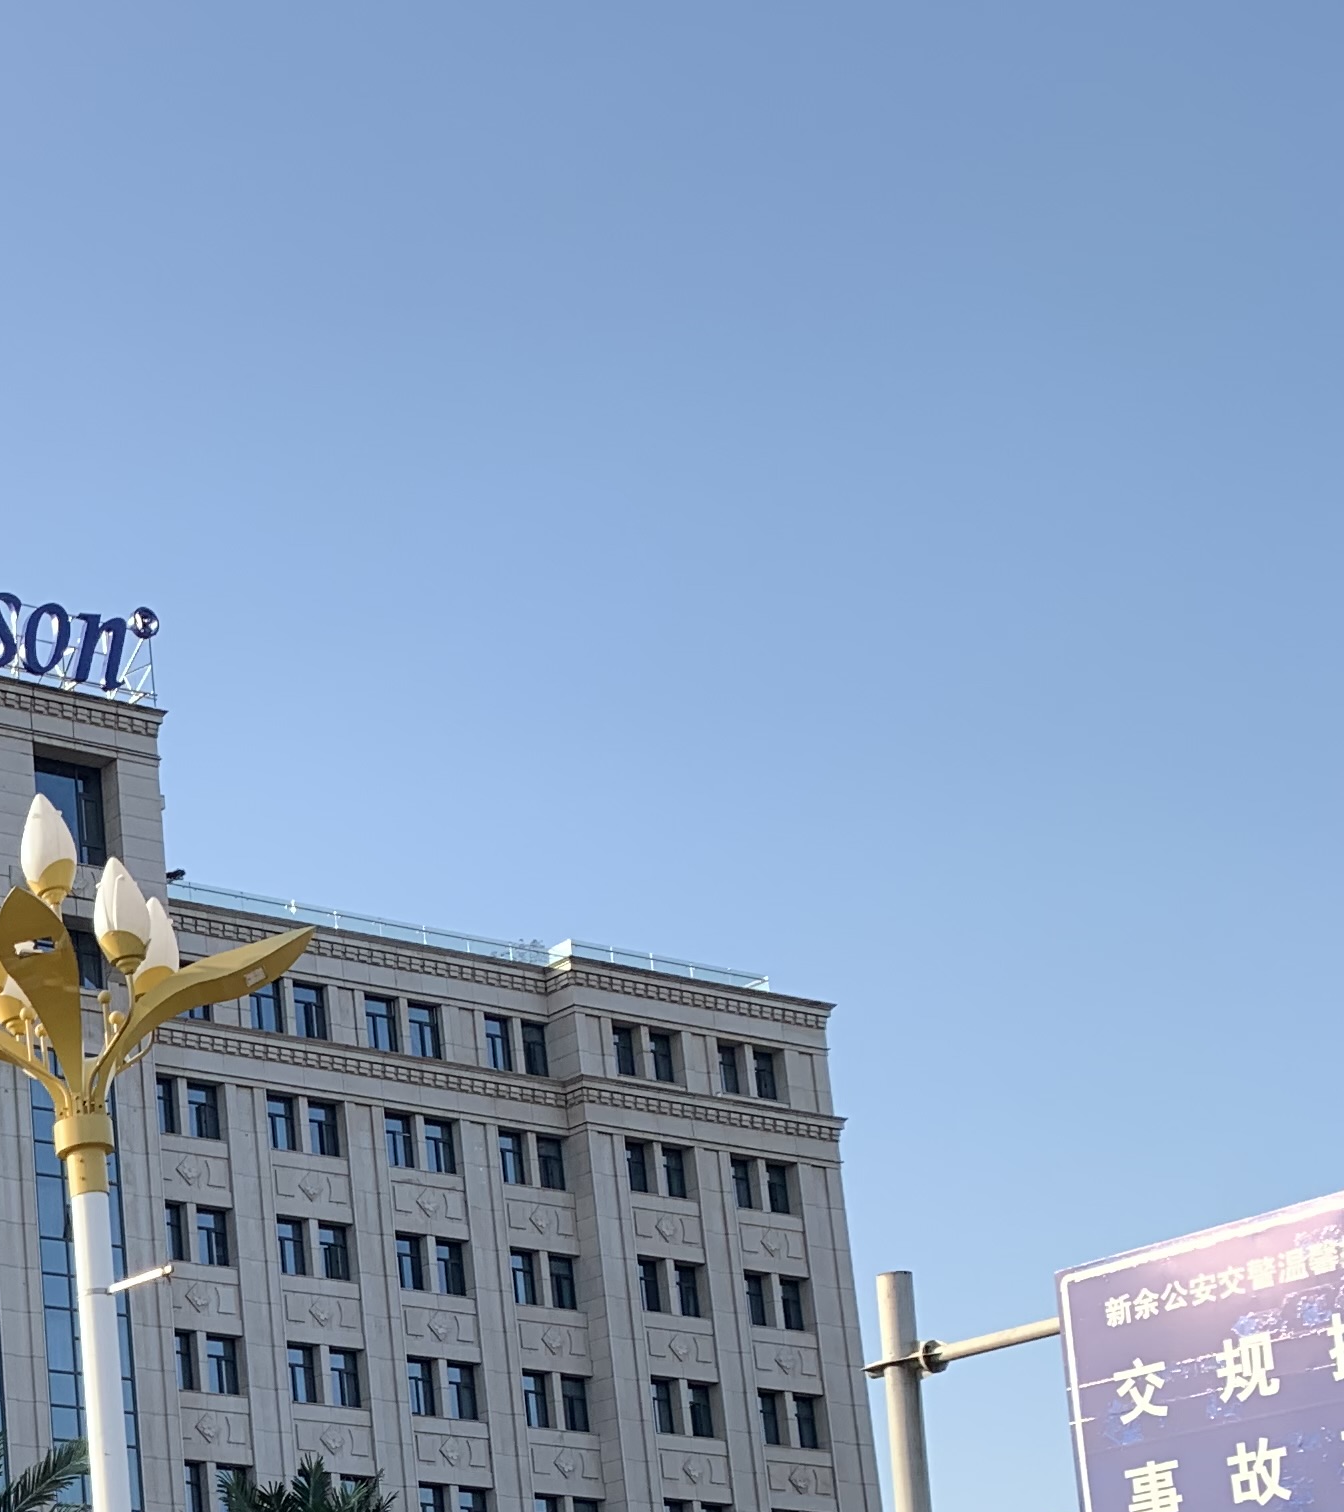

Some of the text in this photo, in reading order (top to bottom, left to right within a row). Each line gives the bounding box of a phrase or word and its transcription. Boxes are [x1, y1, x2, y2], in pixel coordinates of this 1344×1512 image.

[1103, 1236, 1344, 1328] 新余公安交警温馨
